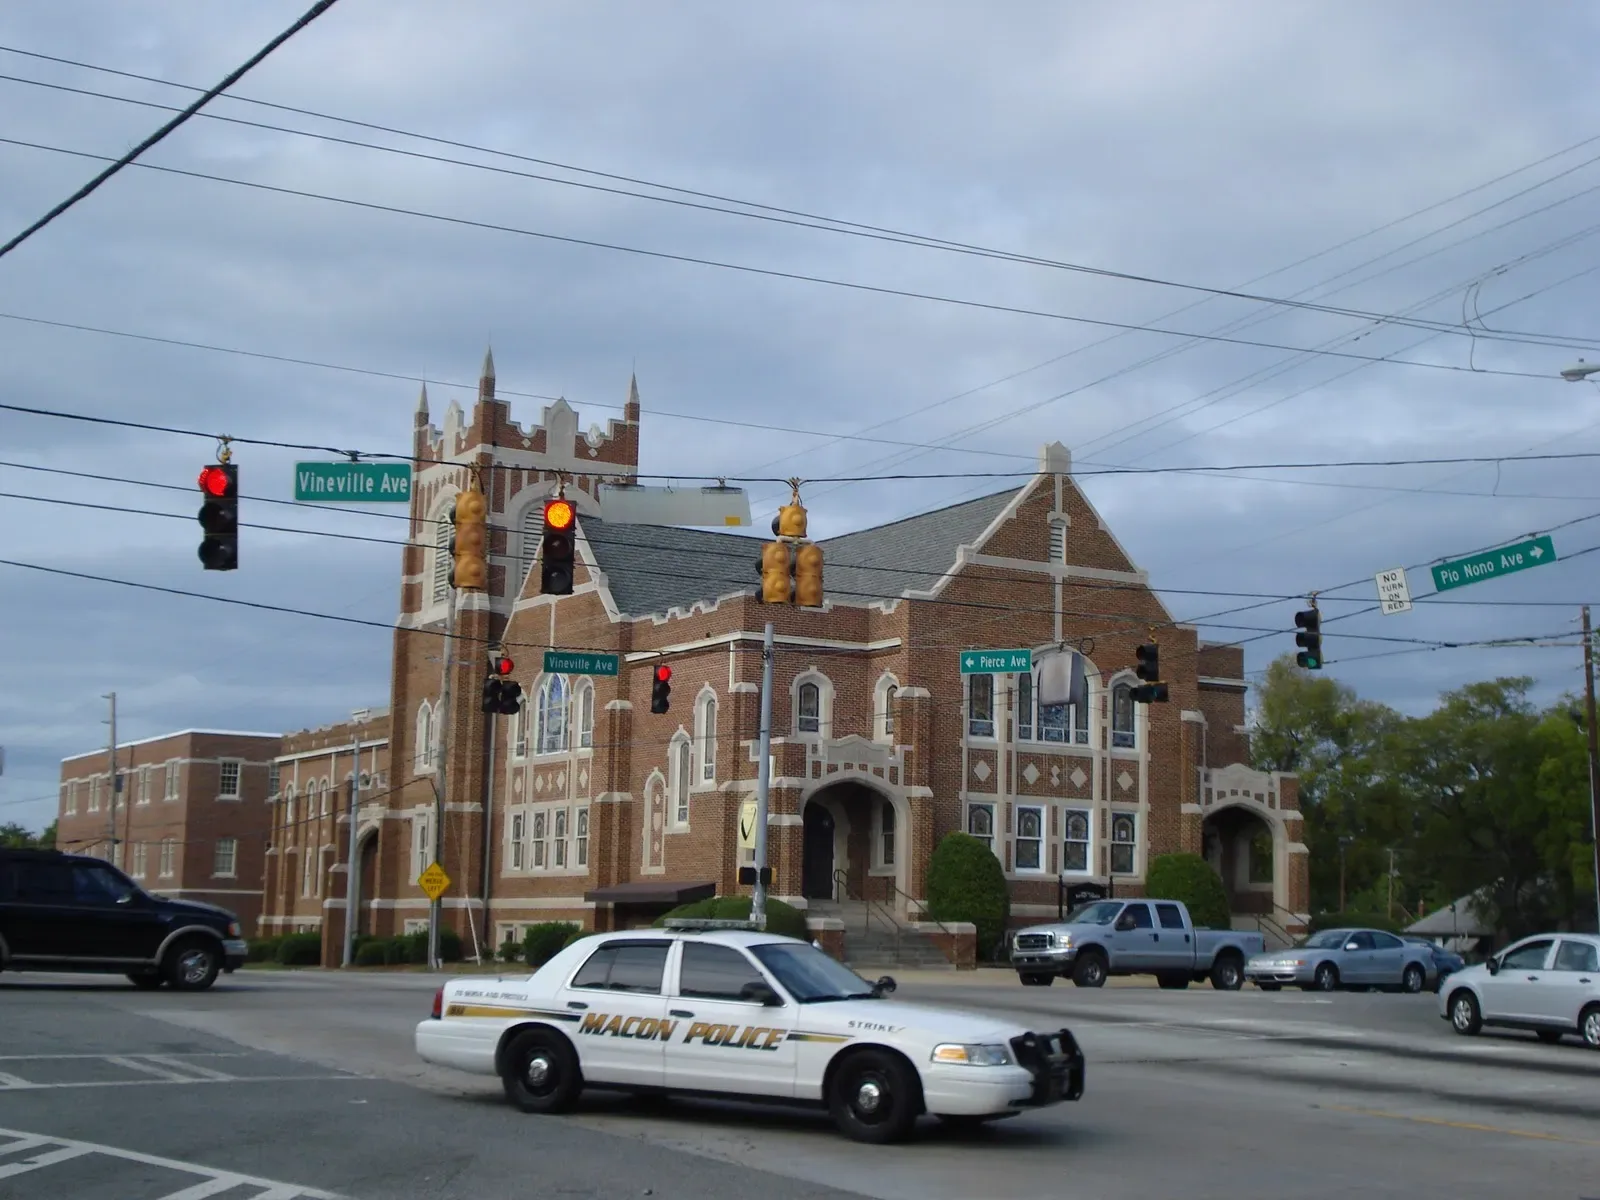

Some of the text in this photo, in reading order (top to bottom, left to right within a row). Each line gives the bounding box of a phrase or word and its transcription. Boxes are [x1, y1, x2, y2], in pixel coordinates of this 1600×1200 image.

[298, 471, 408, 493] Vineville Ave
[1440, 553, 1524, 584] Pio Nono Ave
[1383, 572, 1397, 583] NO
[1381, 582, 1403, 592] TURN
[1388, 592, 1400, 602] ON
[1387, 600, 1405, 611] RED
[549, 656, 613, 671] Vineville Ave
[980, 655, 1026, 668] Pierce Ave
[578, 1012, 788, 1051] MACON POLICE
